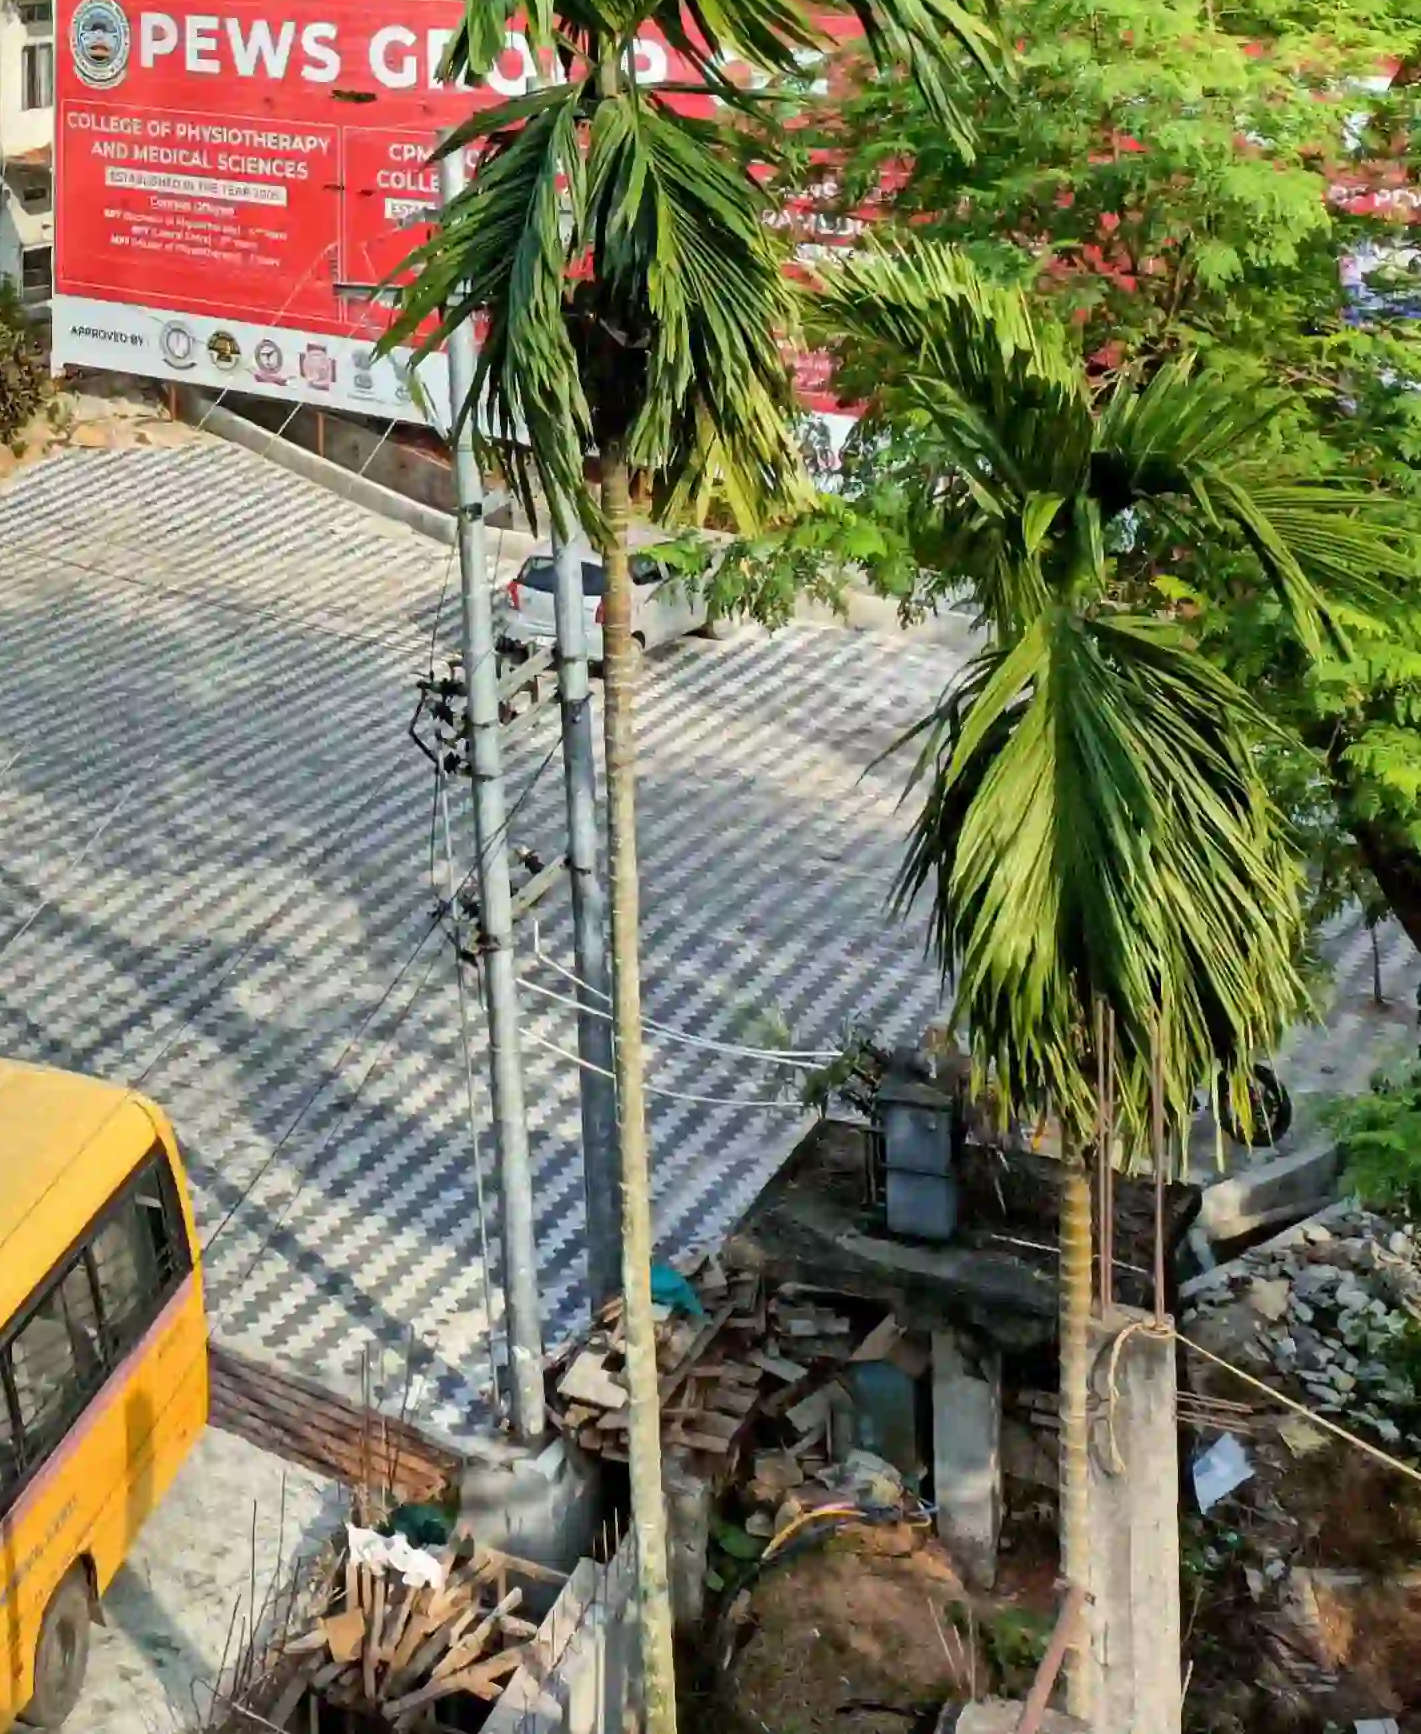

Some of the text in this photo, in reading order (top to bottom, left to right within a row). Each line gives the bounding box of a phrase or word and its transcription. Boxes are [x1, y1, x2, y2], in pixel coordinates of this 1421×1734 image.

[140, 12, 341, 83] PEWS
[67, 112, 331, 155] COLLEGE OF PHYSIOTHERAPY
[91, 141, 309, 180] AND MEDICAL SCIENCES
[388, 143, 435, 163] CPM
[376, 170, 440, 193] COLLE
[69, 325, 128, 343] APPROVED
